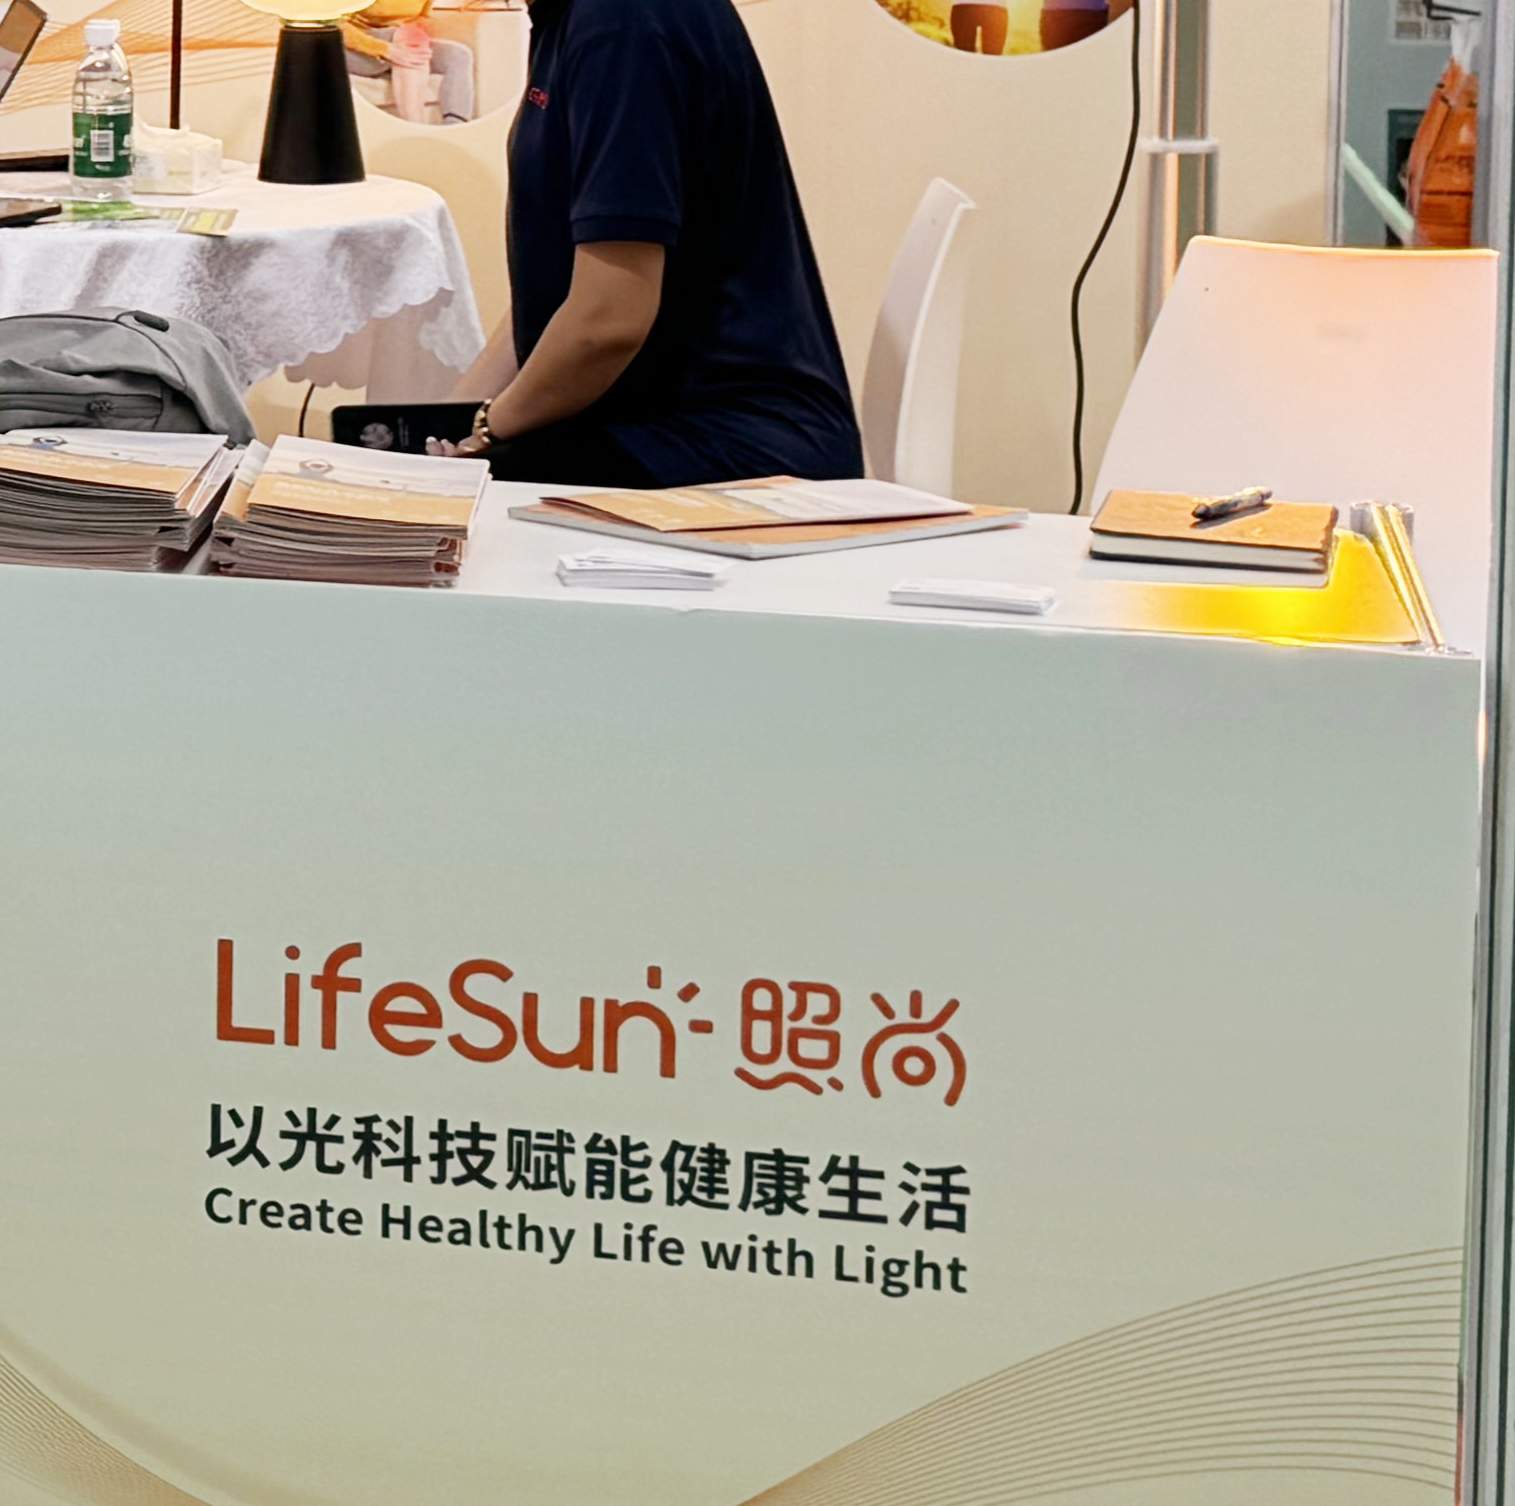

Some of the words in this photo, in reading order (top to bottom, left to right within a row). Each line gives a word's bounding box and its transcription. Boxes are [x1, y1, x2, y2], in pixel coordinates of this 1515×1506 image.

[213, 936, 678, 1082] LifeSun
[734, 976, 968, 1108] 照尚
[205, 1102, 972, 1237] 以光科技赋能健康生活
[205, 1188, 365, 1243] Create
[379, 1200, 576, 1266] Healthy
[591, 1218, 686, 1270] Life
[699, 1227, 819, 1282] with
[833, 1236, 970, 1299] Light
